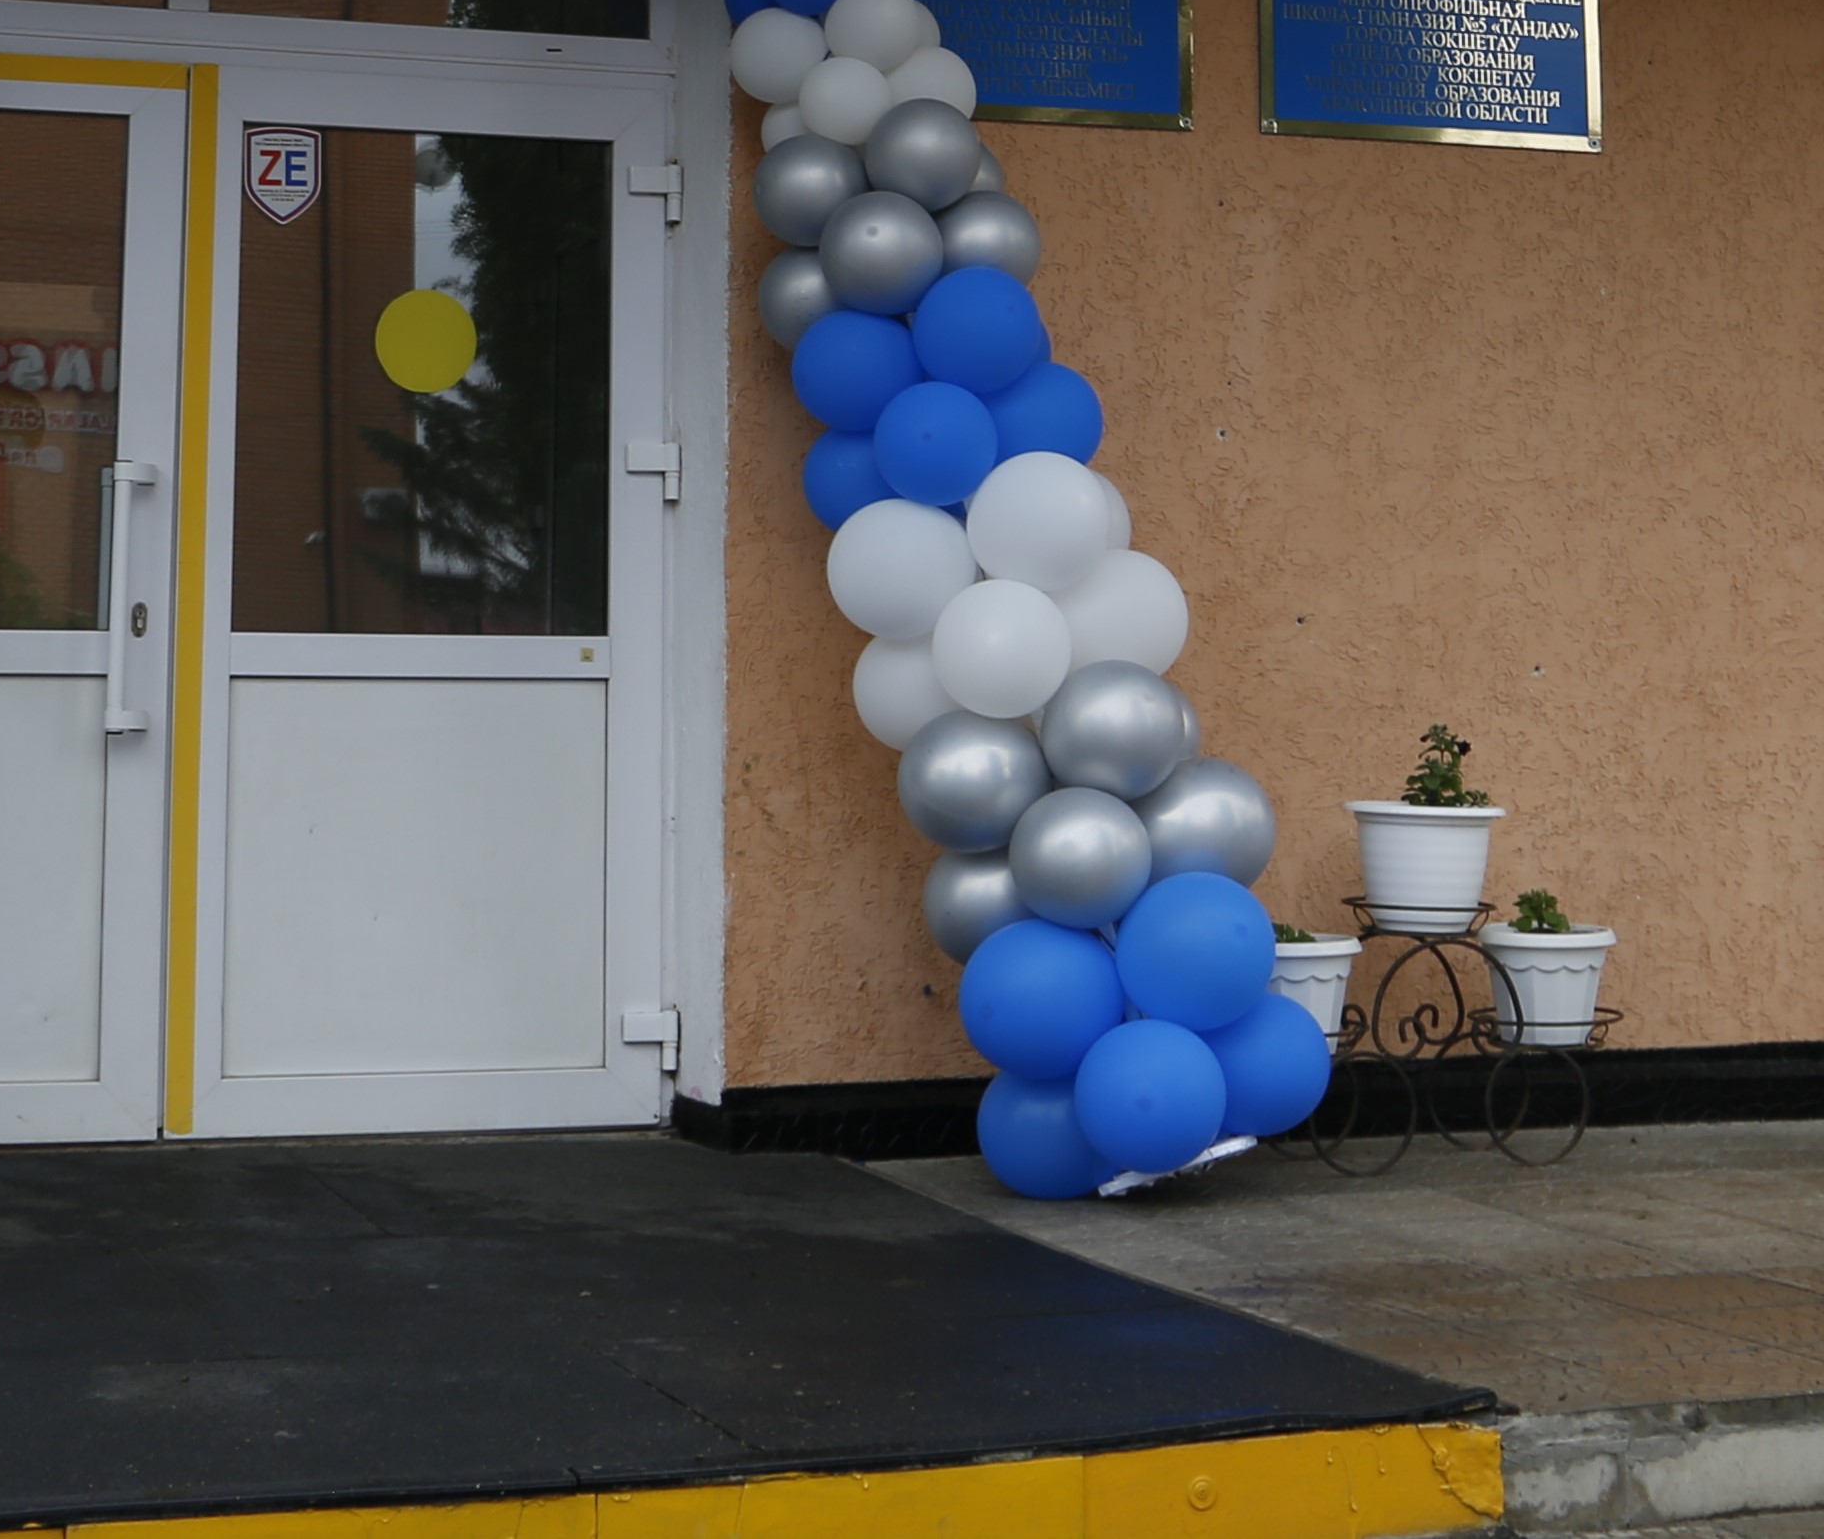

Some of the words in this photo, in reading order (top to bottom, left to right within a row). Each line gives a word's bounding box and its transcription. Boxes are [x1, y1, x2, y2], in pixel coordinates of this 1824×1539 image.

[1283, 4, 1457, 30] ШКОЛА-ГИМНАЗИЯ
[1460, 18, 1487, 33] №5
[1345, 26, 1416, 45] ГОРОДА
[1422, 33, 1520, 52] КОКШЕТАУ
[1330, 43, 1402, 63] ОТДЕЛА
[1408, 47, 1535, 71] ОБРАЗОВАНИЯ
[1365, 63, 1432, 85] ГОРОДУ
[1437, 67, 1536, 87] КОКШЕТАУ
[1305, 76, 1425, 98] УПРАВЛЕНИЯ
[1435, 85, 1560, 108] ОБРАЗОВАНИЯ
[1319, 98, 1461, 119] АКМОЛИНСКОЙ
[1466, 103, 1549, 125] ОБЛАСТИ
[258, 149, 308, 186] ZE
